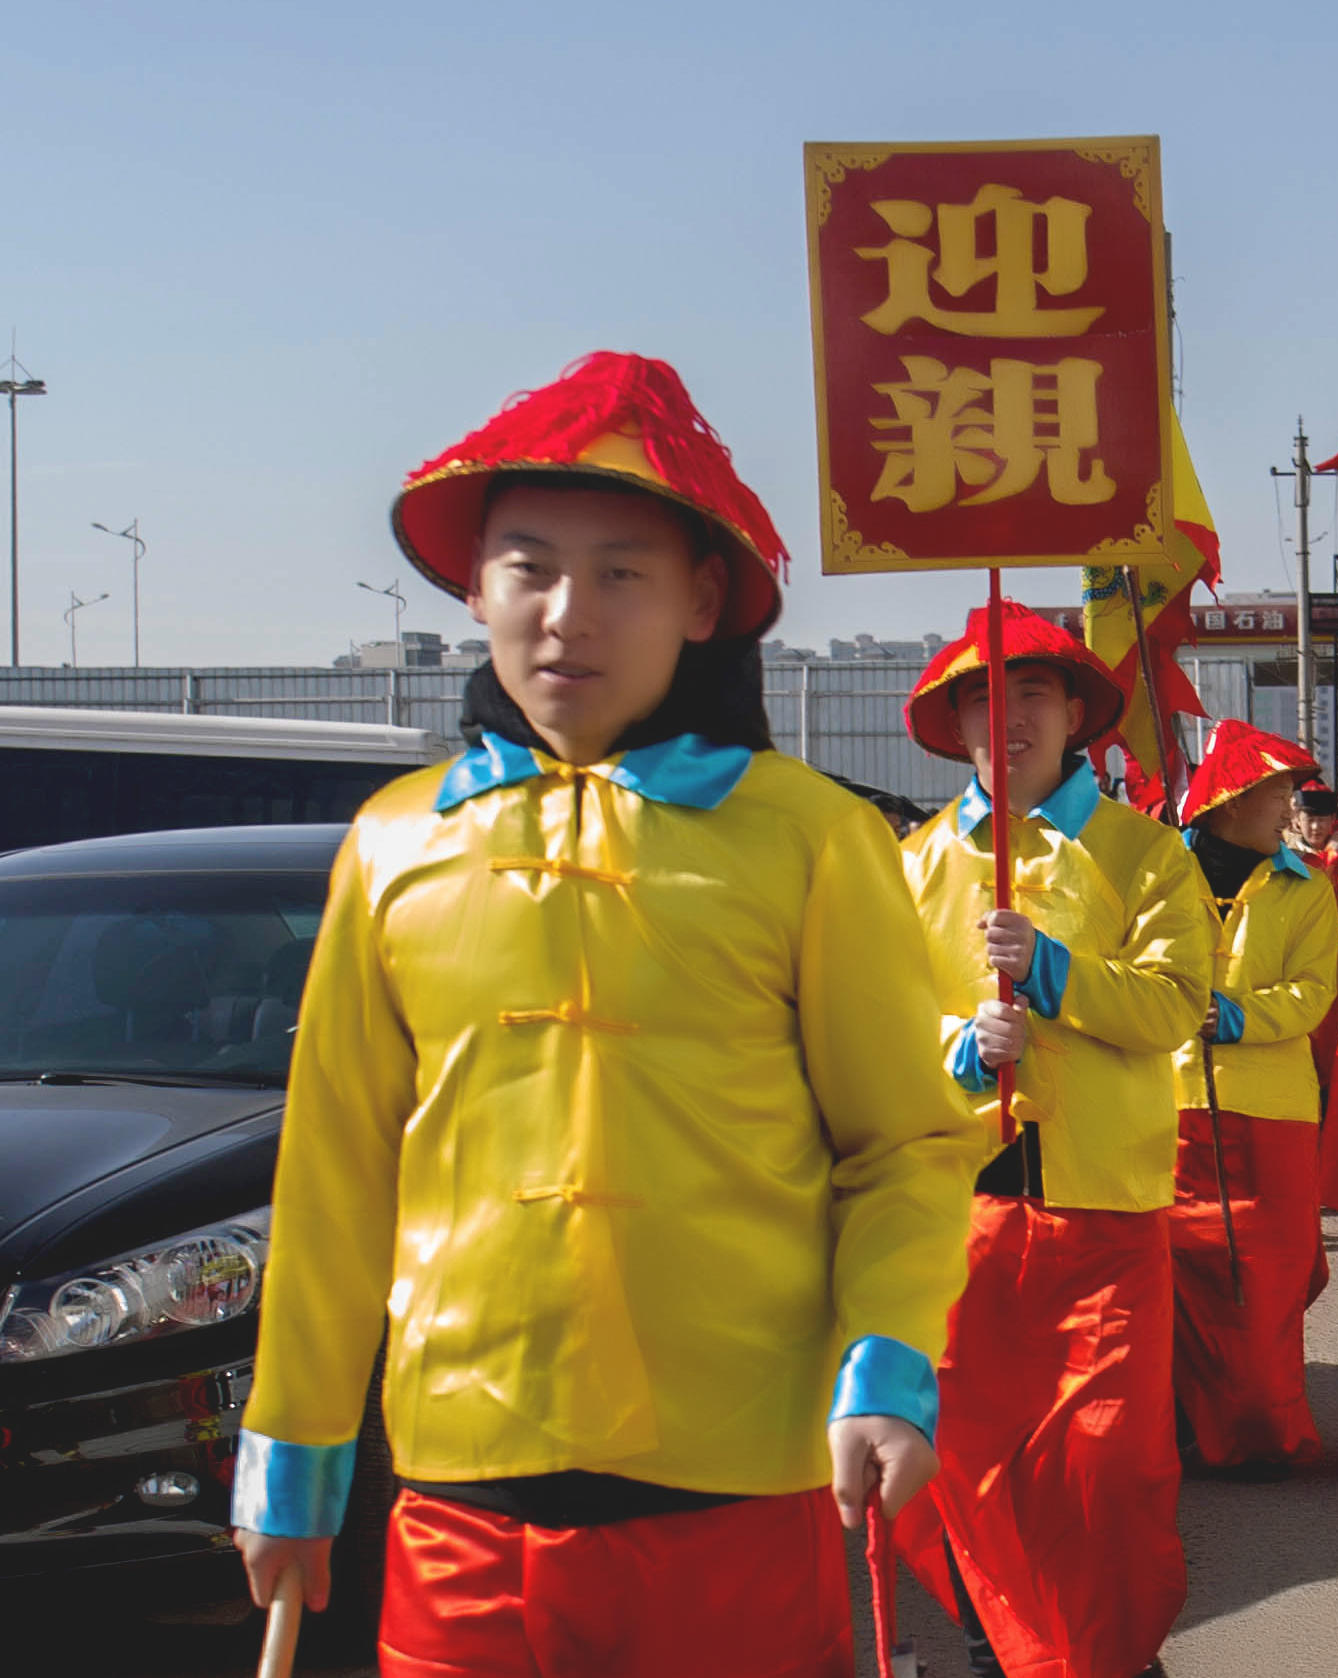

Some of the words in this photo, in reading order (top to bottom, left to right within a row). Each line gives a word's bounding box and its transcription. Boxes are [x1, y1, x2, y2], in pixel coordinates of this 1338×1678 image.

[853, 183, 1117, 512] 迎親
[1191, 610, 1284, 630] 国石油
